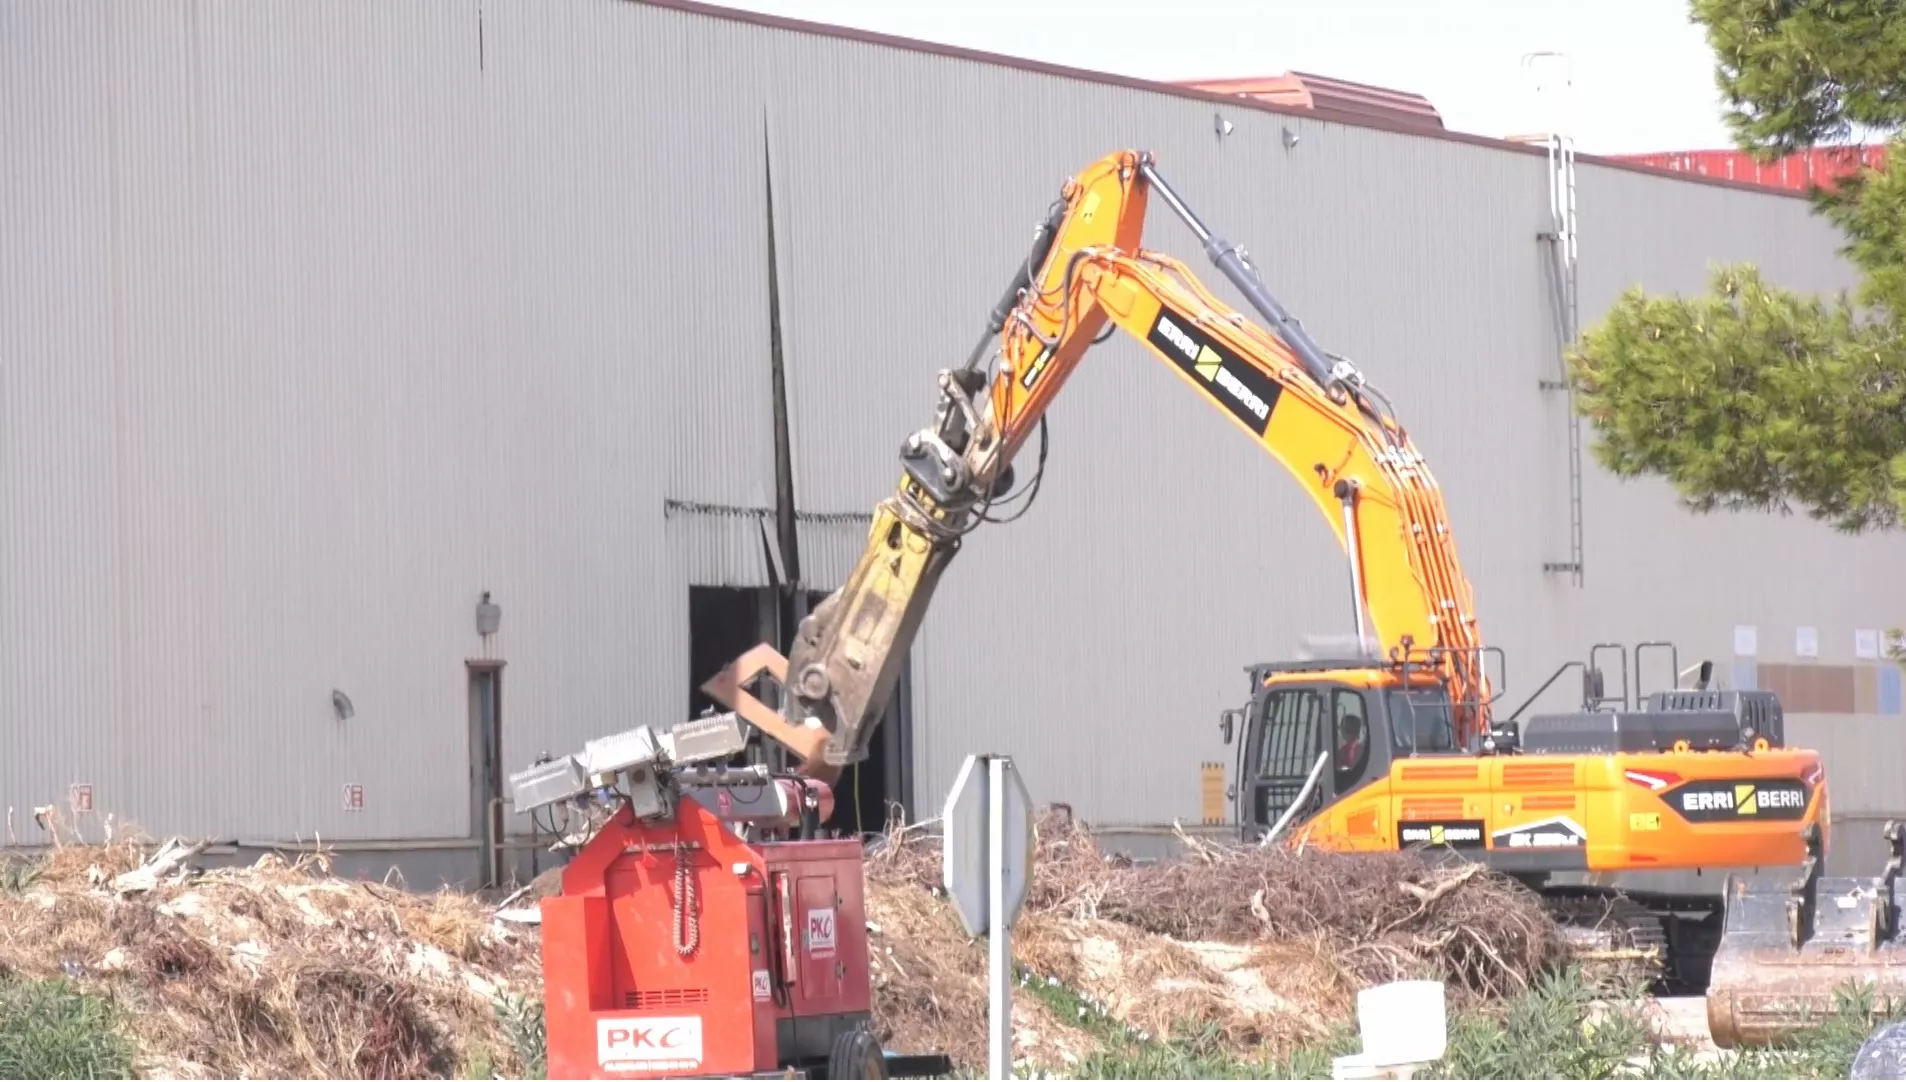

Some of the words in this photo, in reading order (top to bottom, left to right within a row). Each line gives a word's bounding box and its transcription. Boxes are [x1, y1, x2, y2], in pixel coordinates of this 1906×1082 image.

[1157, 316, 1200, 360] ERRI
[1215, 366, 1270, 420] BERRI
[1682, 791, 1734, 810] ERRI
[1757, 789, 1805, 808] BERRI
